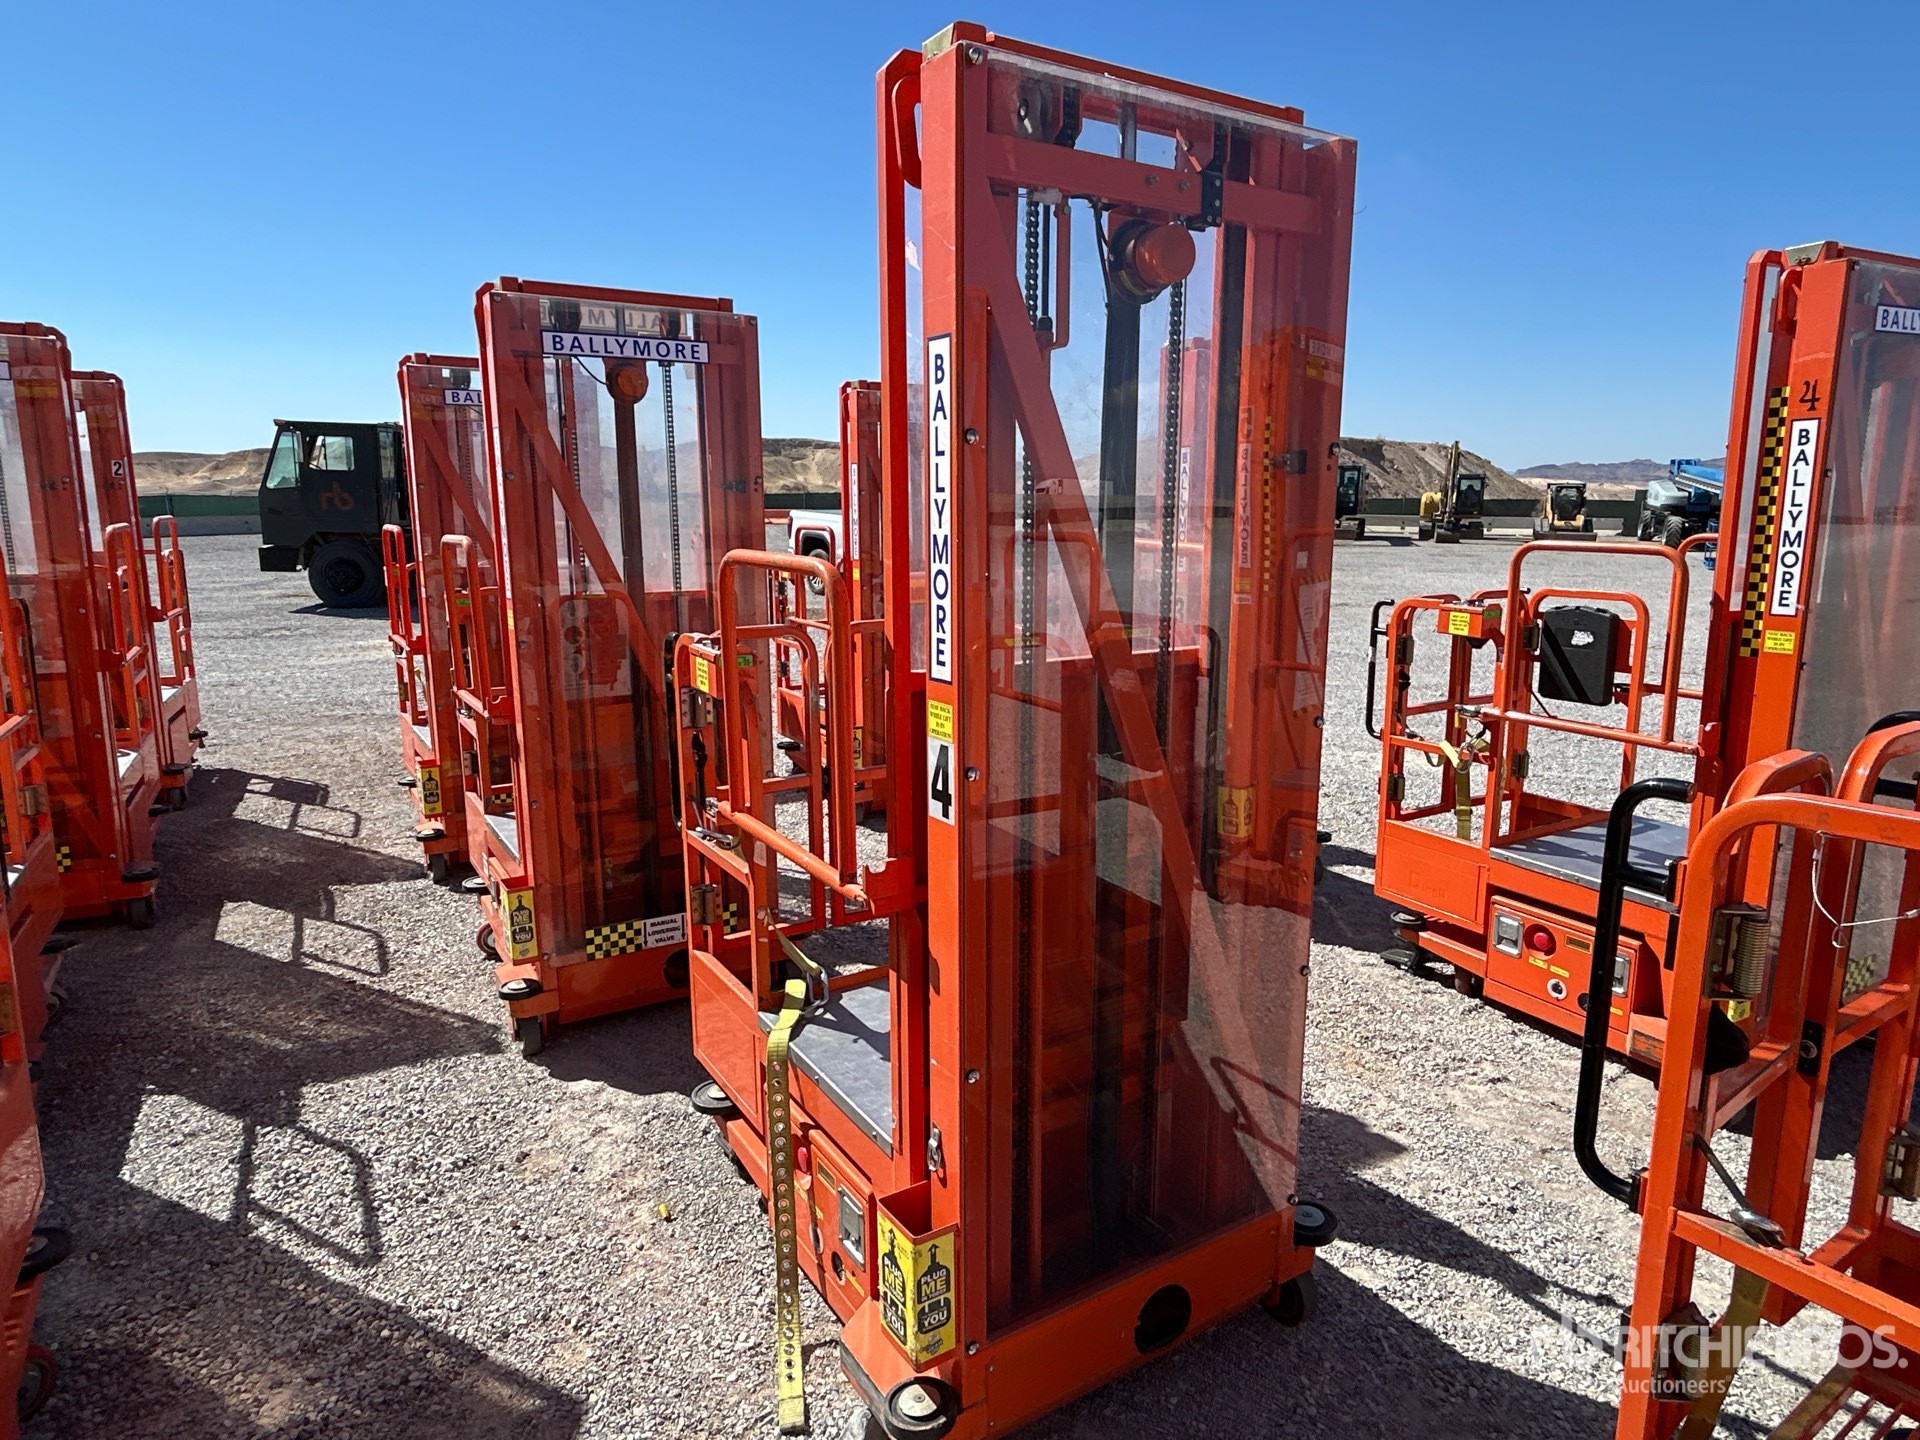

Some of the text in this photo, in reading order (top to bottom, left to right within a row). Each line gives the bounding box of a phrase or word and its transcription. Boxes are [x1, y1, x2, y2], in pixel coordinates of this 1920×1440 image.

[1881, 309, 1920, 331] BALL
[551, 334, 701, 360] BALLYMORE
[1799, 379, 1821, 411] 4
[113, 461, 123, 477] 2
[932, 352, 949, 667] BALLYMORE
[1778, 428, 1811, 608] BALLYMORE
[931, 743, 952, 820] 4
[513, 914, 530, 923] ME
[650, 917, 678, 928] MANUAL
[515, 932, 532, 941] YOU
[647, 925, 681, 937] LOWERING
[654, 934, 675, 944] VALVE
[884, 1255, 903, 1283] PLUG
[920, 1268, 947, 1285] PLUG
[884, 1265, 904, 1297] ME
[921, 1276, 947, 1297] ME
[886, 1307, 905, 1336] YOU
[923, 1309, 947, 1328] YOU
